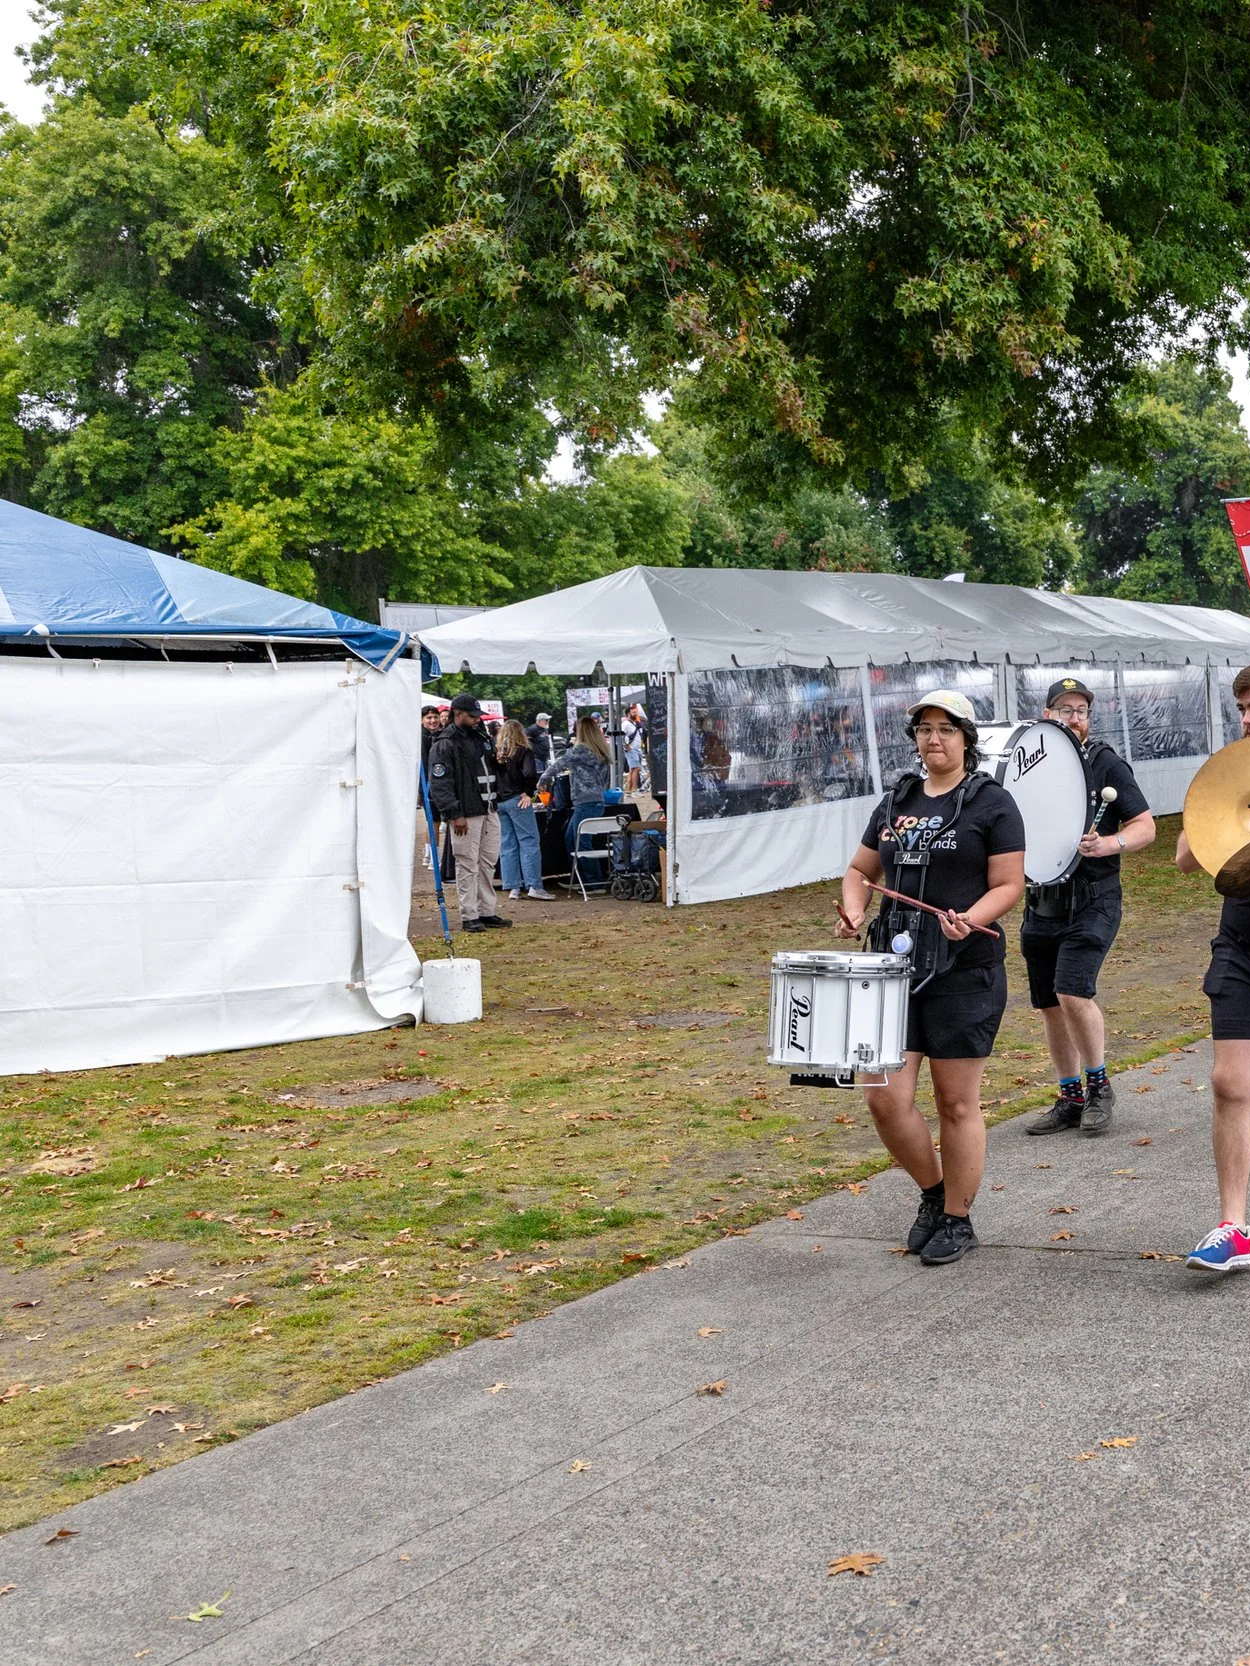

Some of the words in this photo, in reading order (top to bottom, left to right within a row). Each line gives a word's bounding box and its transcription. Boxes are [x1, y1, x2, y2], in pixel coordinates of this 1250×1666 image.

[1013, 733, 1047, 782] Pearl
[894, 815, 943, 830] rose
[899, 852, 922, 865] Pearl
[788, 986, 811, 1053] Pearl
